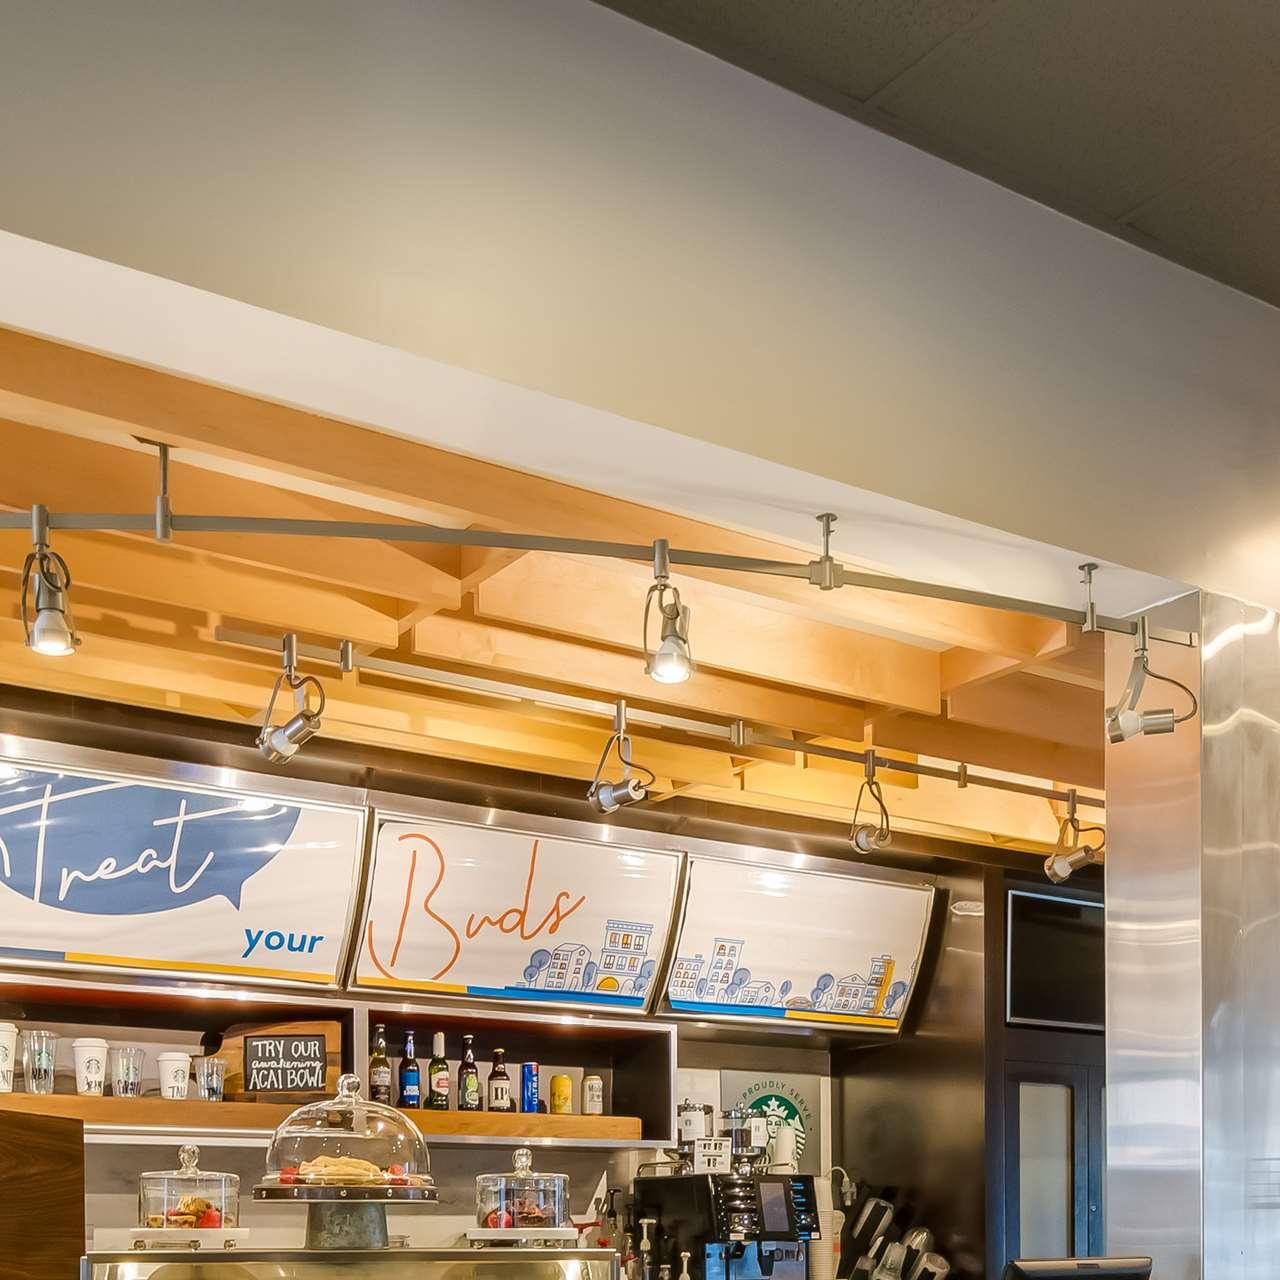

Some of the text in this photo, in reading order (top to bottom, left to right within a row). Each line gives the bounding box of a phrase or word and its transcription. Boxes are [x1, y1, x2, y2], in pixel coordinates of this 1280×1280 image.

[368, 832, 586, 981] Buds
[241, 927, 325, 958] your
[252, 1040, 320, 1058] TRY OUR
[251, 1058, 324, 1074] awakening
[249, 1069, 326, 1090] ACAI BOWL
[742, 1080, 813, 1120] PROUDLY SERVE
